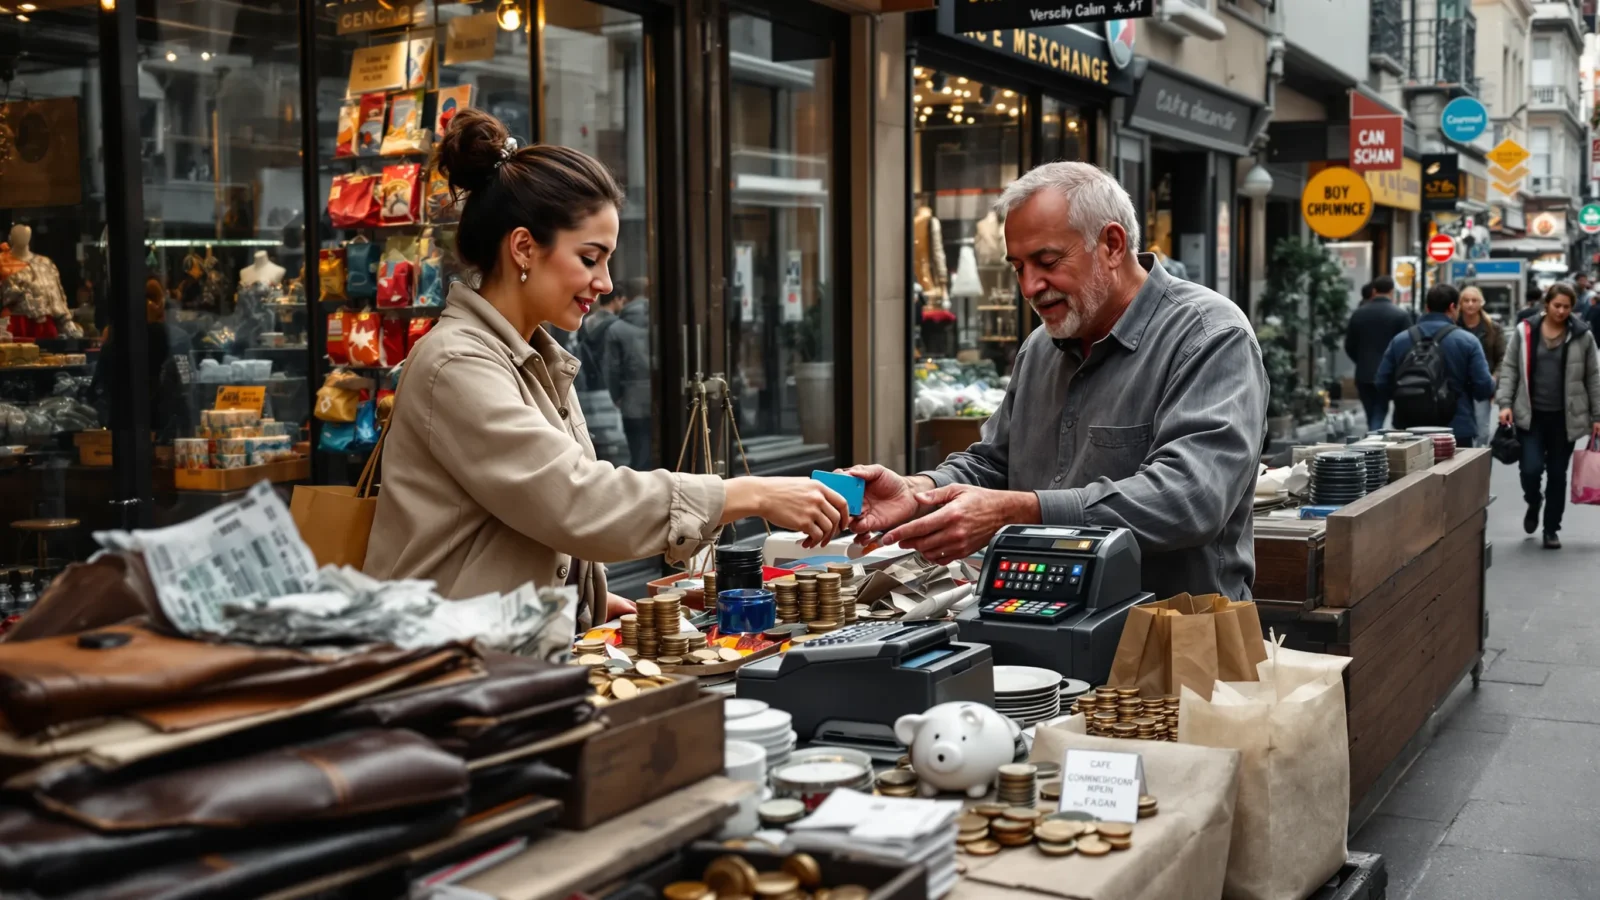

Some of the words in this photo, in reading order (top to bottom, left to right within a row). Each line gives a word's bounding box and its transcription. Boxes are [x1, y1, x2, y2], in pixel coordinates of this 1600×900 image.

[1013, 28, 1109, 85] MEXCHANGE
[1358, 129, 1385, 146] CAN
[1353, 148, 1395, 164] SCHAN
[1324, 185, 1350, 200] BOY
[1090, 760, 1112, 769] CAFE
